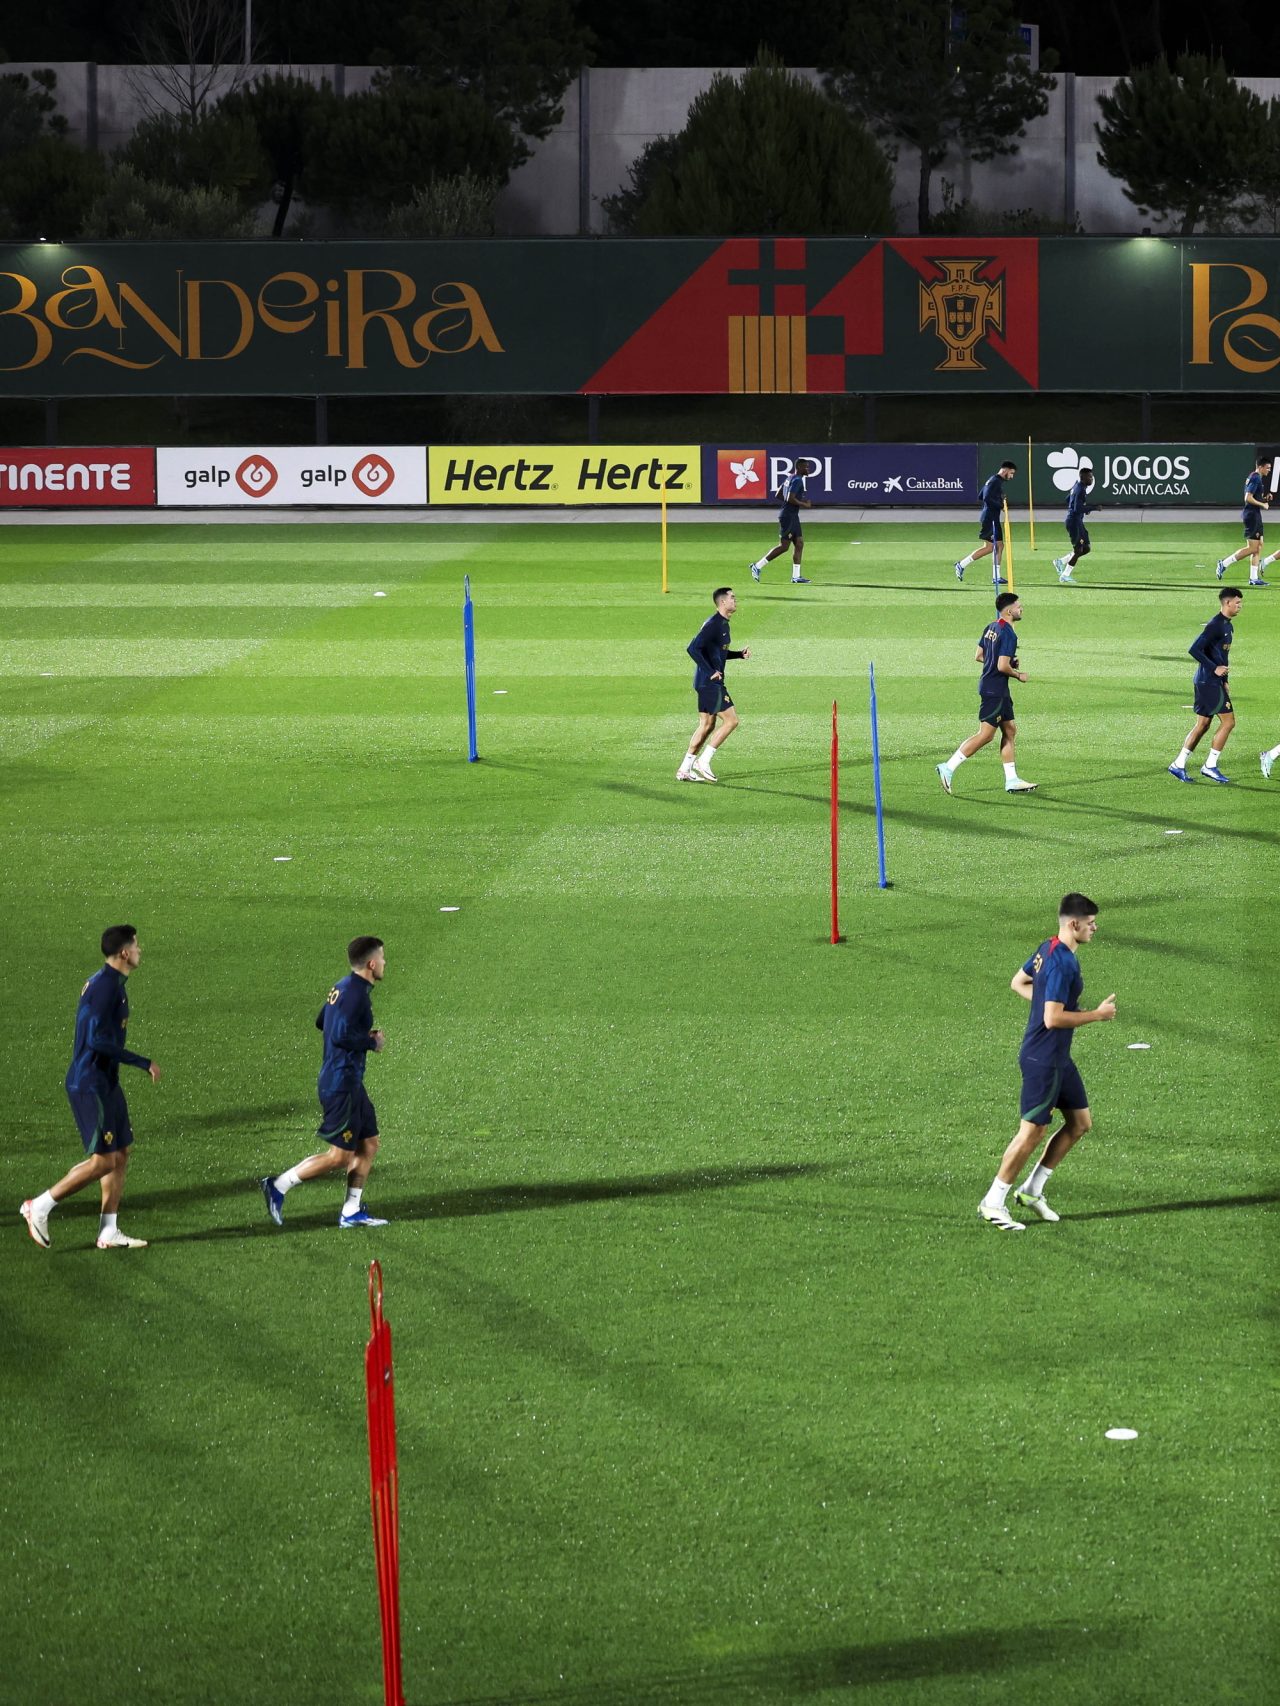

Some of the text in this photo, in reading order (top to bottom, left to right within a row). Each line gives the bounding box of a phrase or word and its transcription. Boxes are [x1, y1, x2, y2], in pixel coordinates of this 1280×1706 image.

[184, 464, 347, 488] galp galp
[444, 458, 688, 491] Hertz Hertz
[770, 456, 833, 492] BPI
[847, 477, 964, 491] Grupo CaixaBank
[1102, 455, 1190, 488] JOGOS
